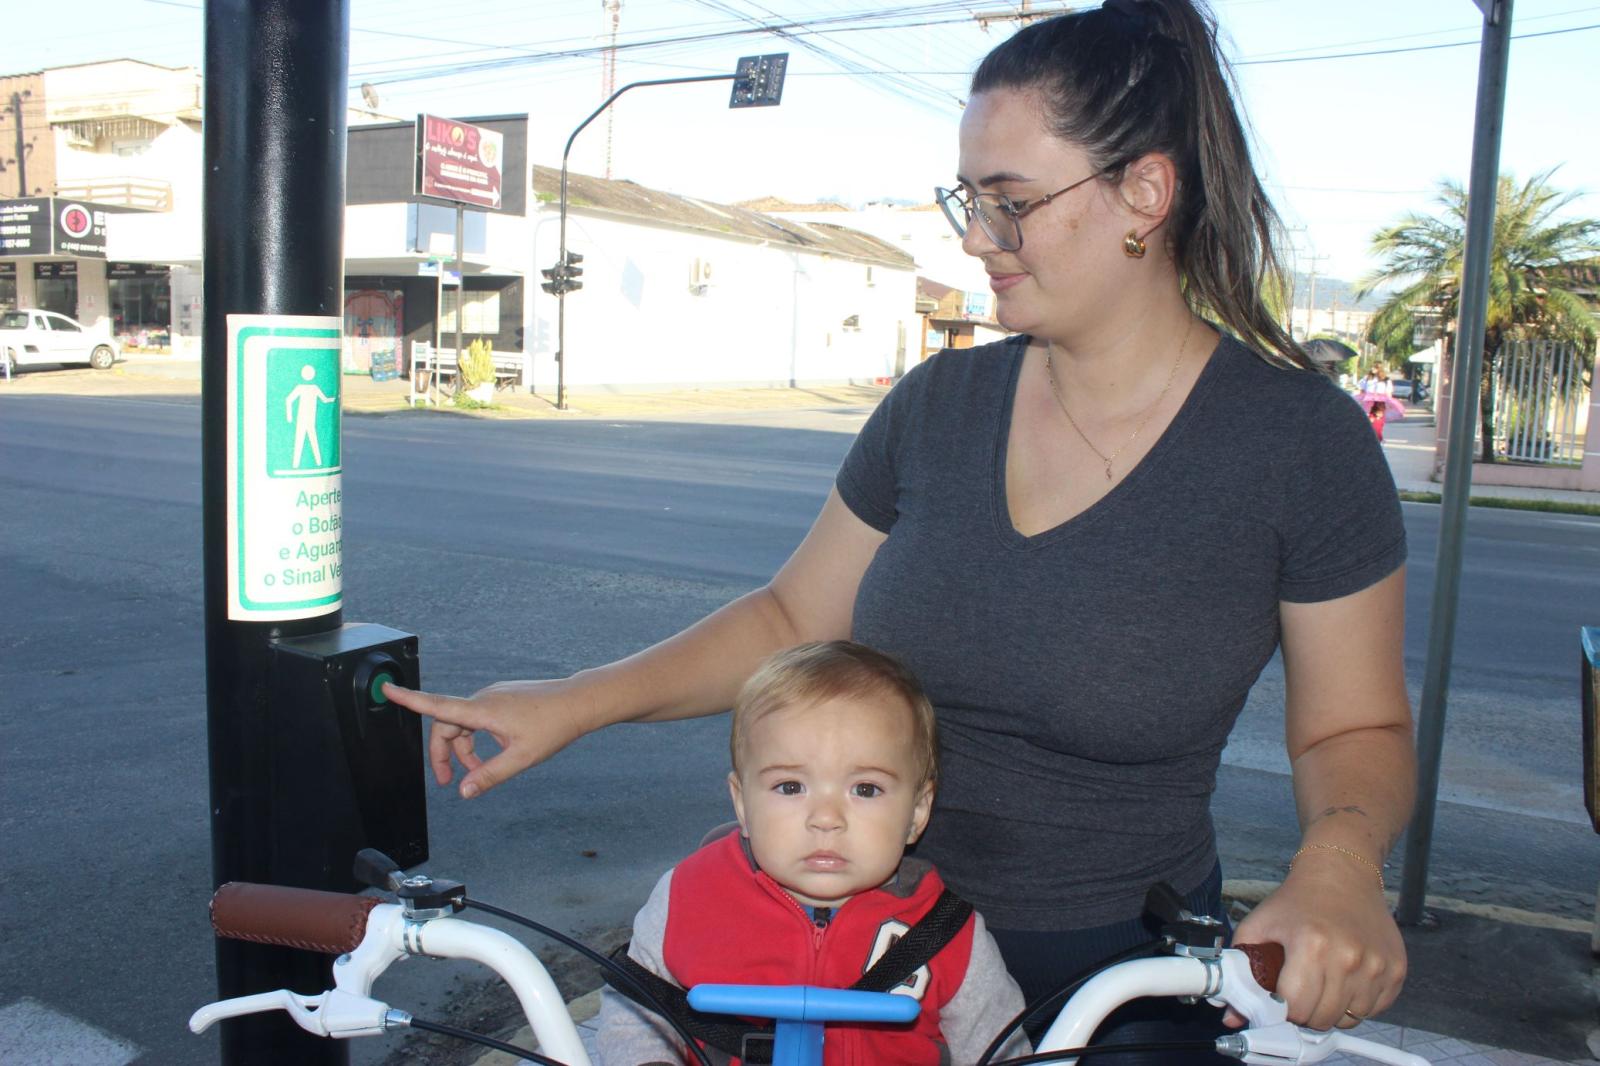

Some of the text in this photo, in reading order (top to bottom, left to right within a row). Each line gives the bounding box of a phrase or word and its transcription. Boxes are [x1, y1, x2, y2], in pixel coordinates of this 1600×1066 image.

[427, 119, 477, 150] LIKO'S
[296, 488, 341, 511] Aperte
[292, 522, 304, 536] o
[279, 547, 290, 560] e
[264, 573, 275, 586] o
[282, 565, 326, 586] Sinal
